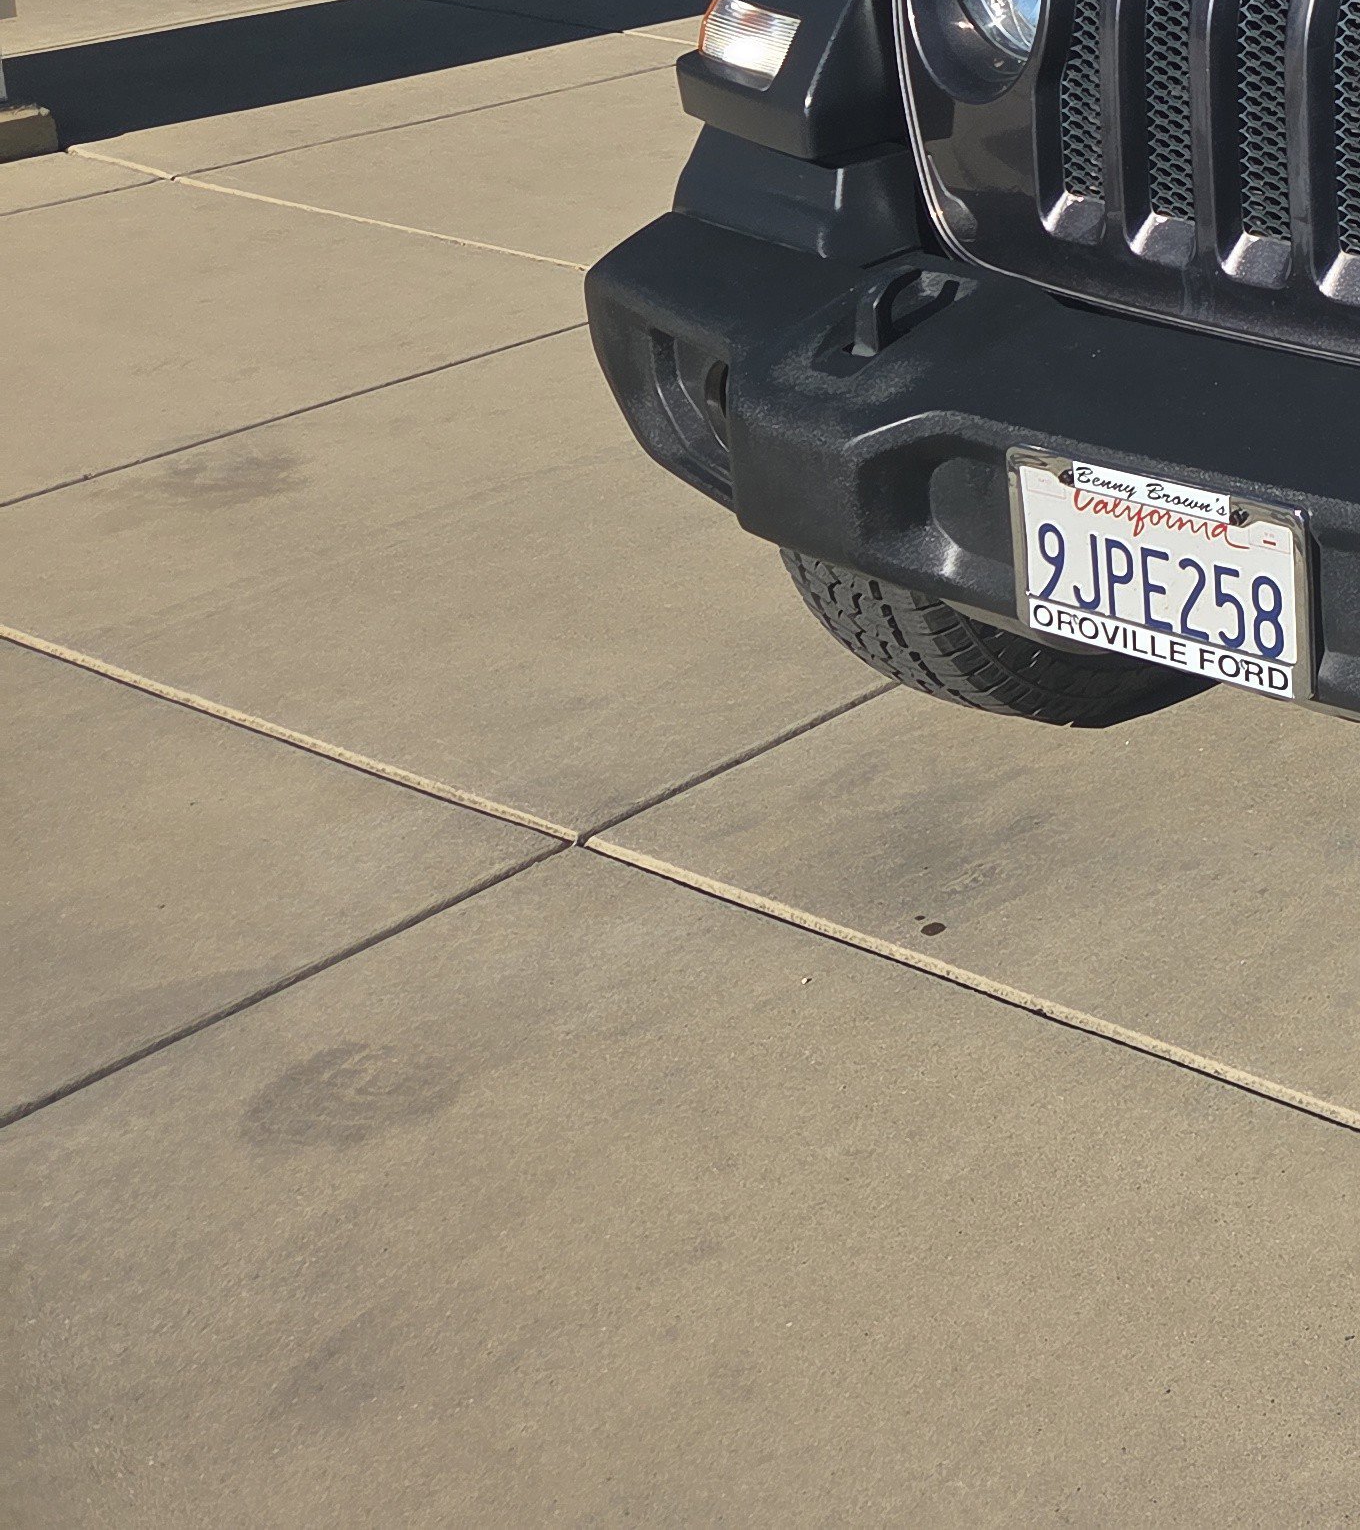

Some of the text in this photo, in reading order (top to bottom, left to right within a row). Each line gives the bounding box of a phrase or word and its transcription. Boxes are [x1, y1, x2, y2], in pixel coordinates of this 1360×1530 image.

[1074, 466, 1229, 517] Benny Brown's
[1037, 522, 1285, 660] 9JPE258
[1033, 603, 1290, 692] OROVILLE FORD
